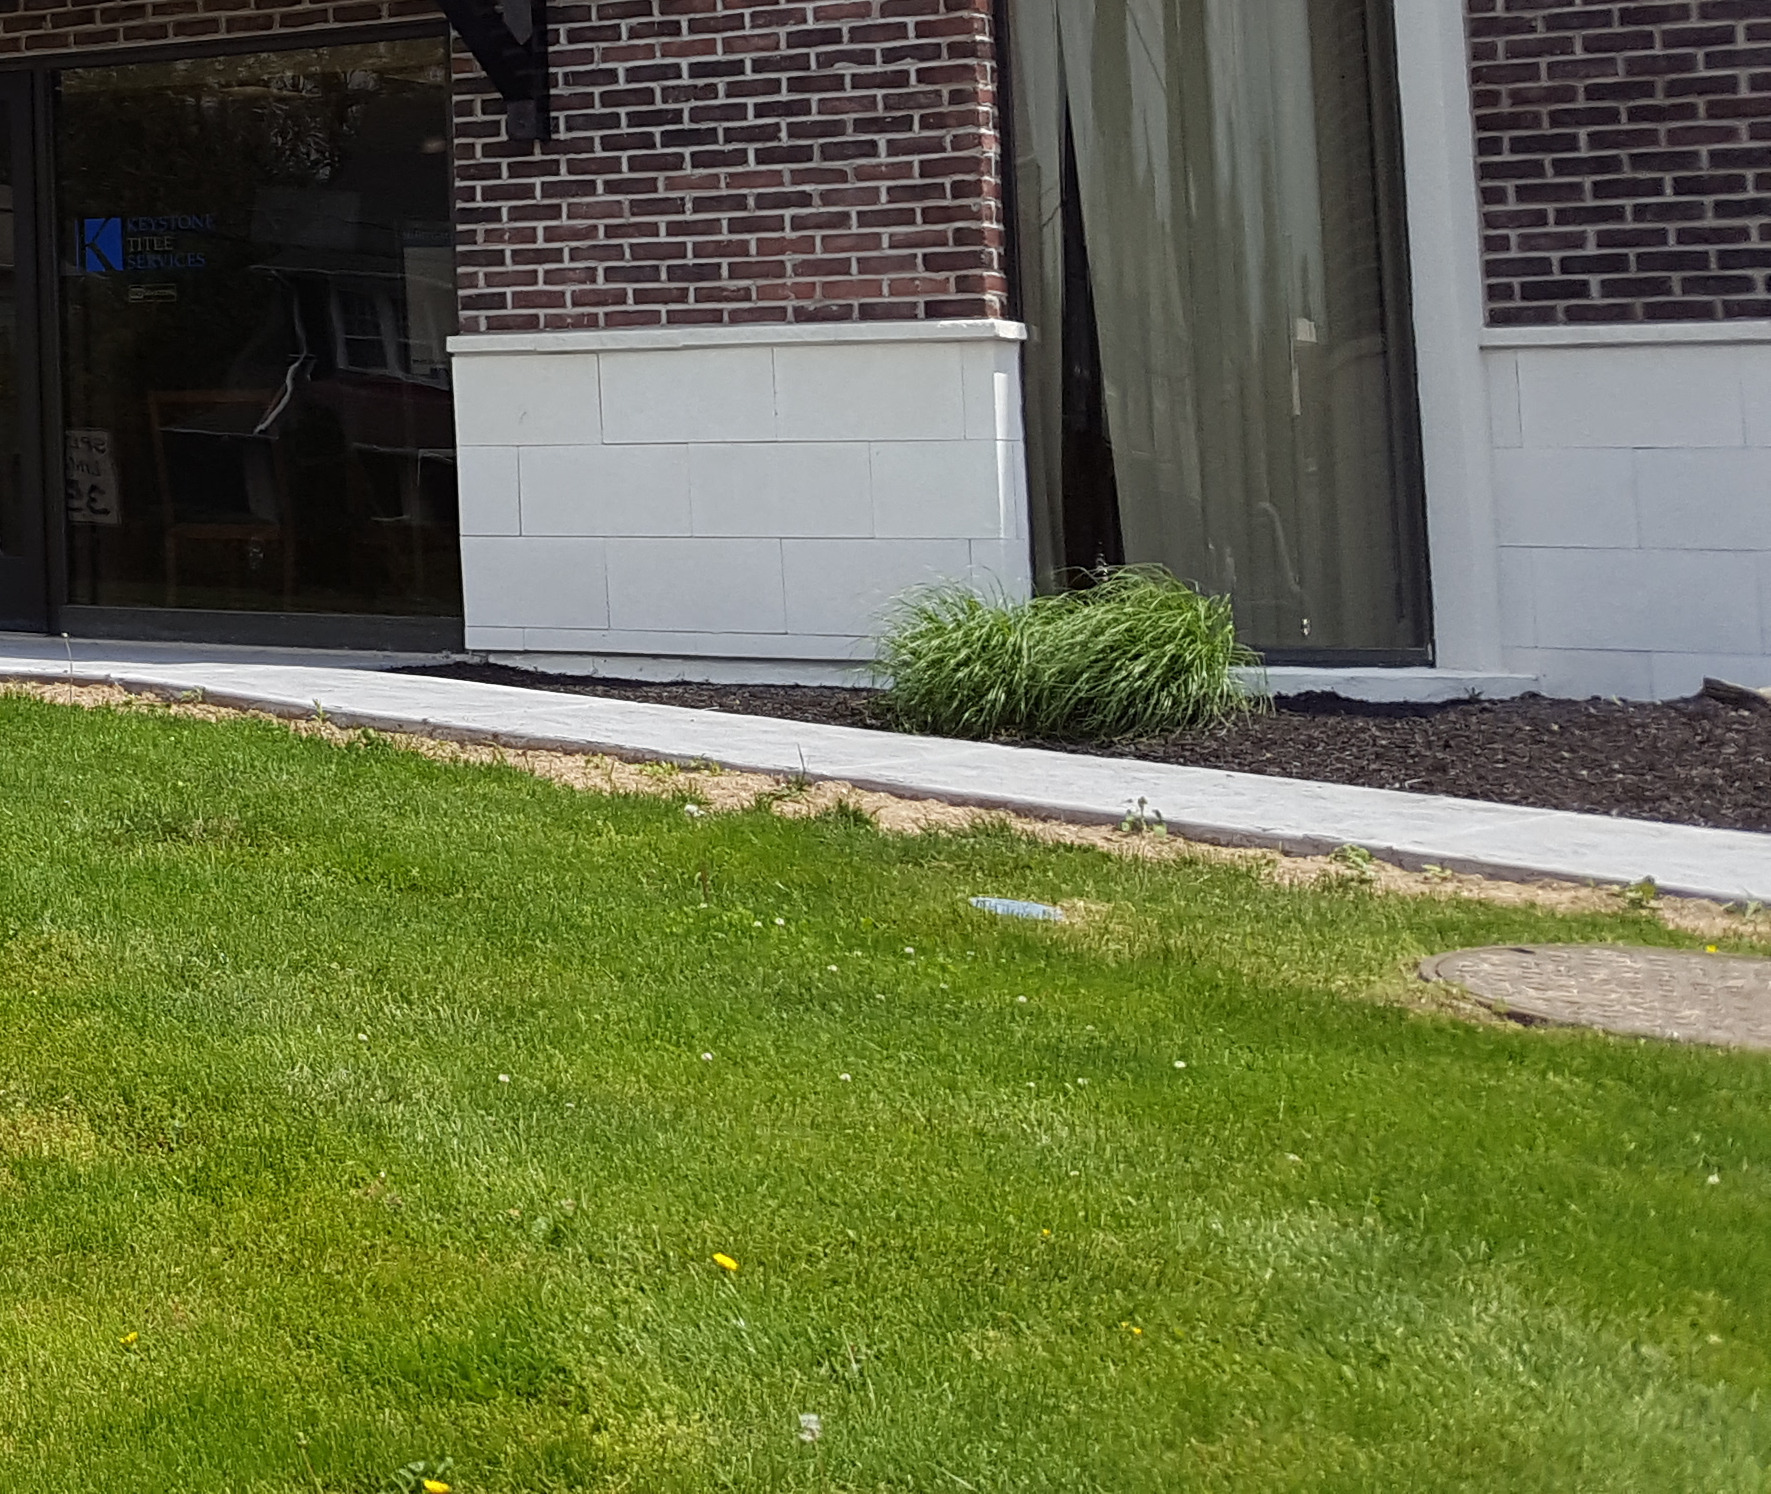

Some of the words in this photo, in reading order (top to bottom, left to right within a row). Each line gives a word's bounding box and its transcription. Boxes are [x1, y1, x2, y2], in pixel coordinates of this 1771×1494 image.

[126, 213, 217, 233] KEYSTONE
[127, 235, 175, 253] TITLE
[127, 251, 207, 270] SERVICES
